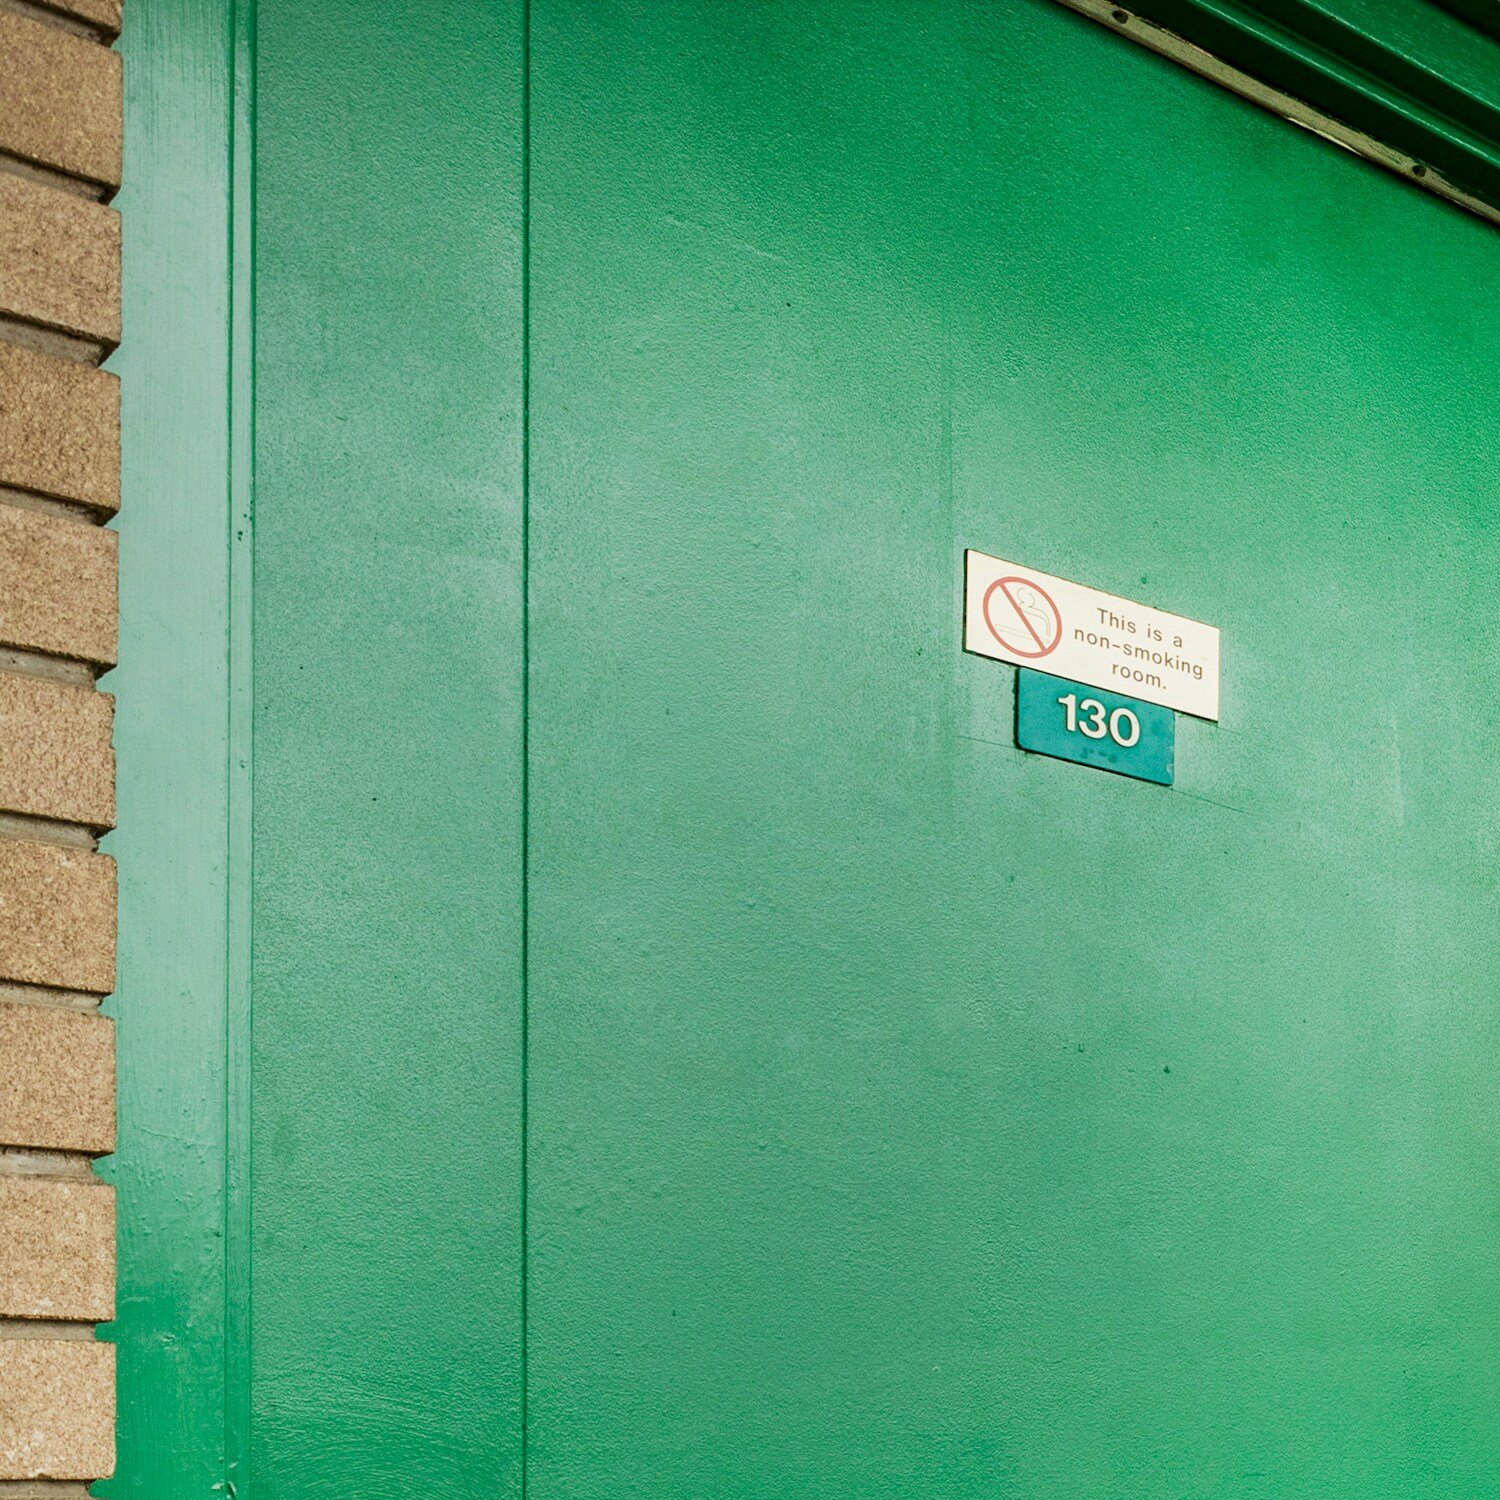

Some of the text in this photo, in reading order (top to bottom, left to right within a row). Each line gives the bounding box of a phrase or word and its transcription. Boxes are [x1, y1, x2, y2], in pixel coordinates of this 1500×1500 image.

[1097, 608, 1183, 648] This is a
[1074, 628, 1203, 680] non-smoking
[1112, 663, 1166, 690] room.
[1058, 693, 1141, 748] 130
